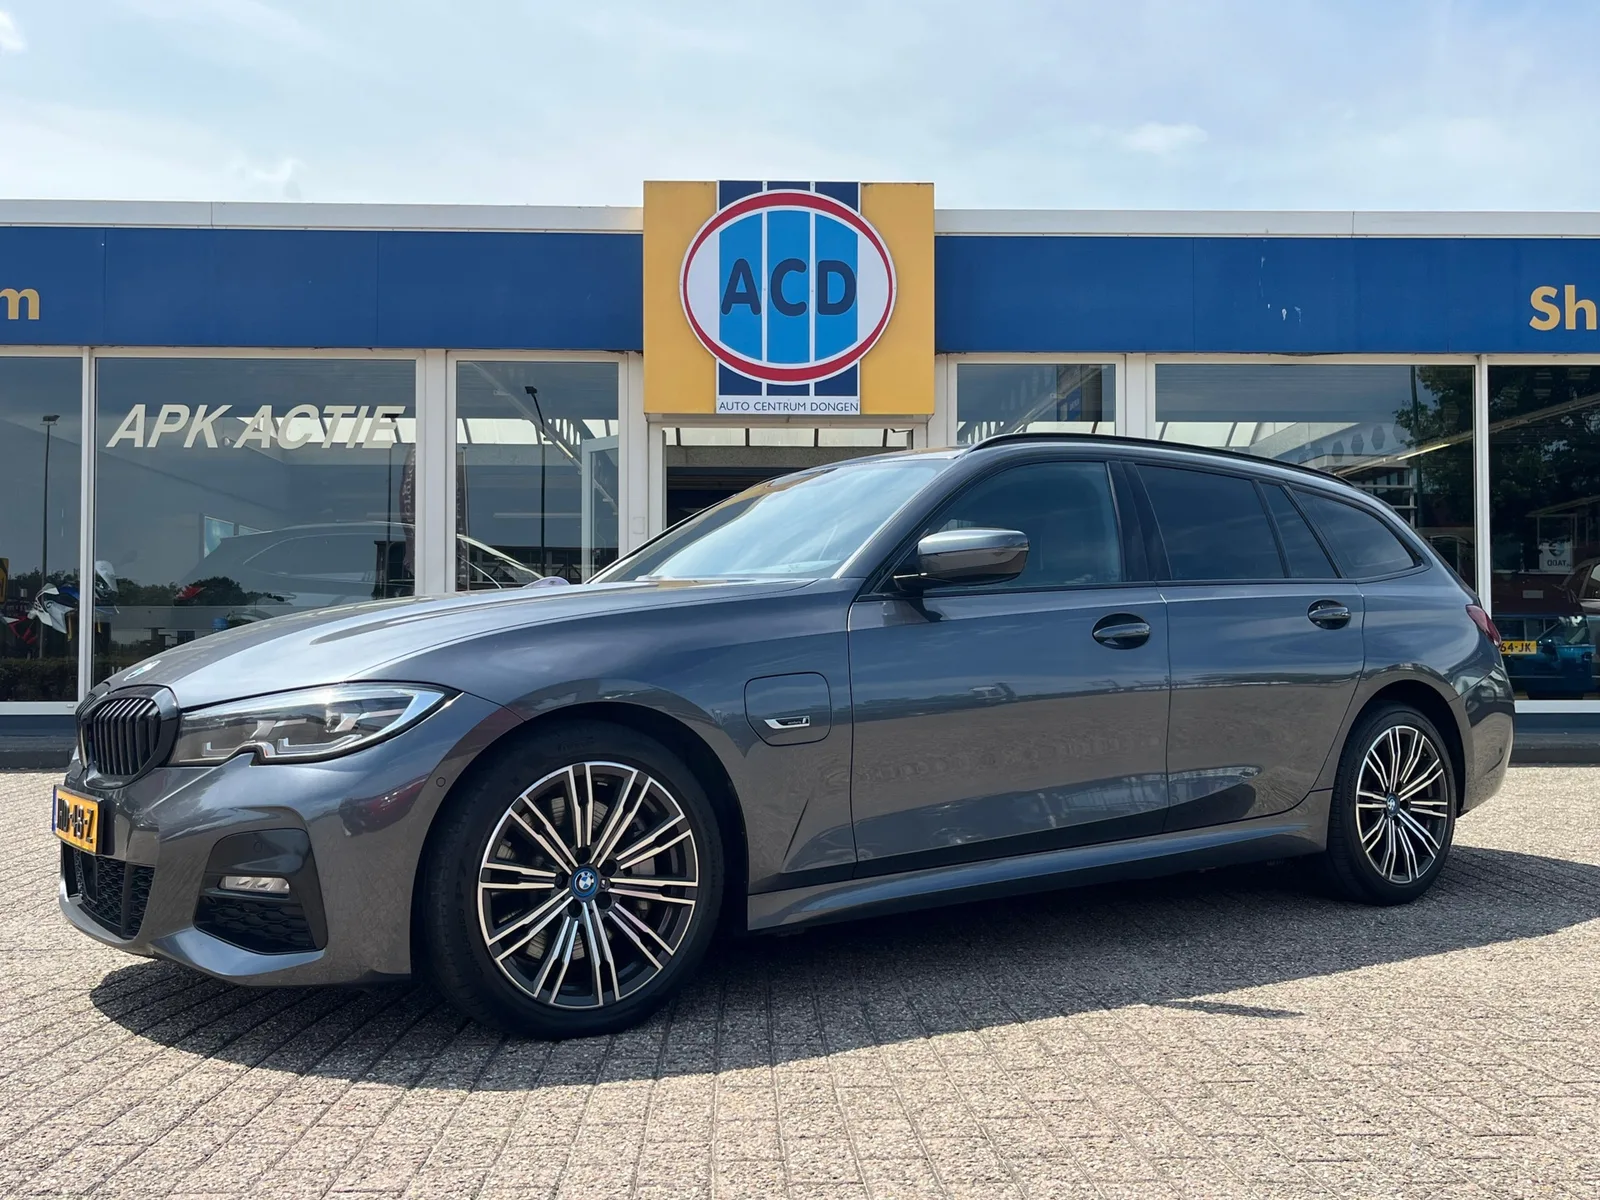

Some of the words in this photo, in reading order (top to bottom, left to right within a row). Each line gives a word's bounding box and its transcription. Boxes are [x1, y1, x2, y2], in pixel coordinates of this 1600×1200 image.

[720, 258, 857, 316] ACD
[1529, 285, 1597, 331] Sh
[106, 403, 232, 449] APK
[233, 403, 406, 449] ACTIE
[719, 402, 750, 411] AUTO
[754, 401, 806, 411] CENTRUM
[810, 401, 859, 411] DONGEN
